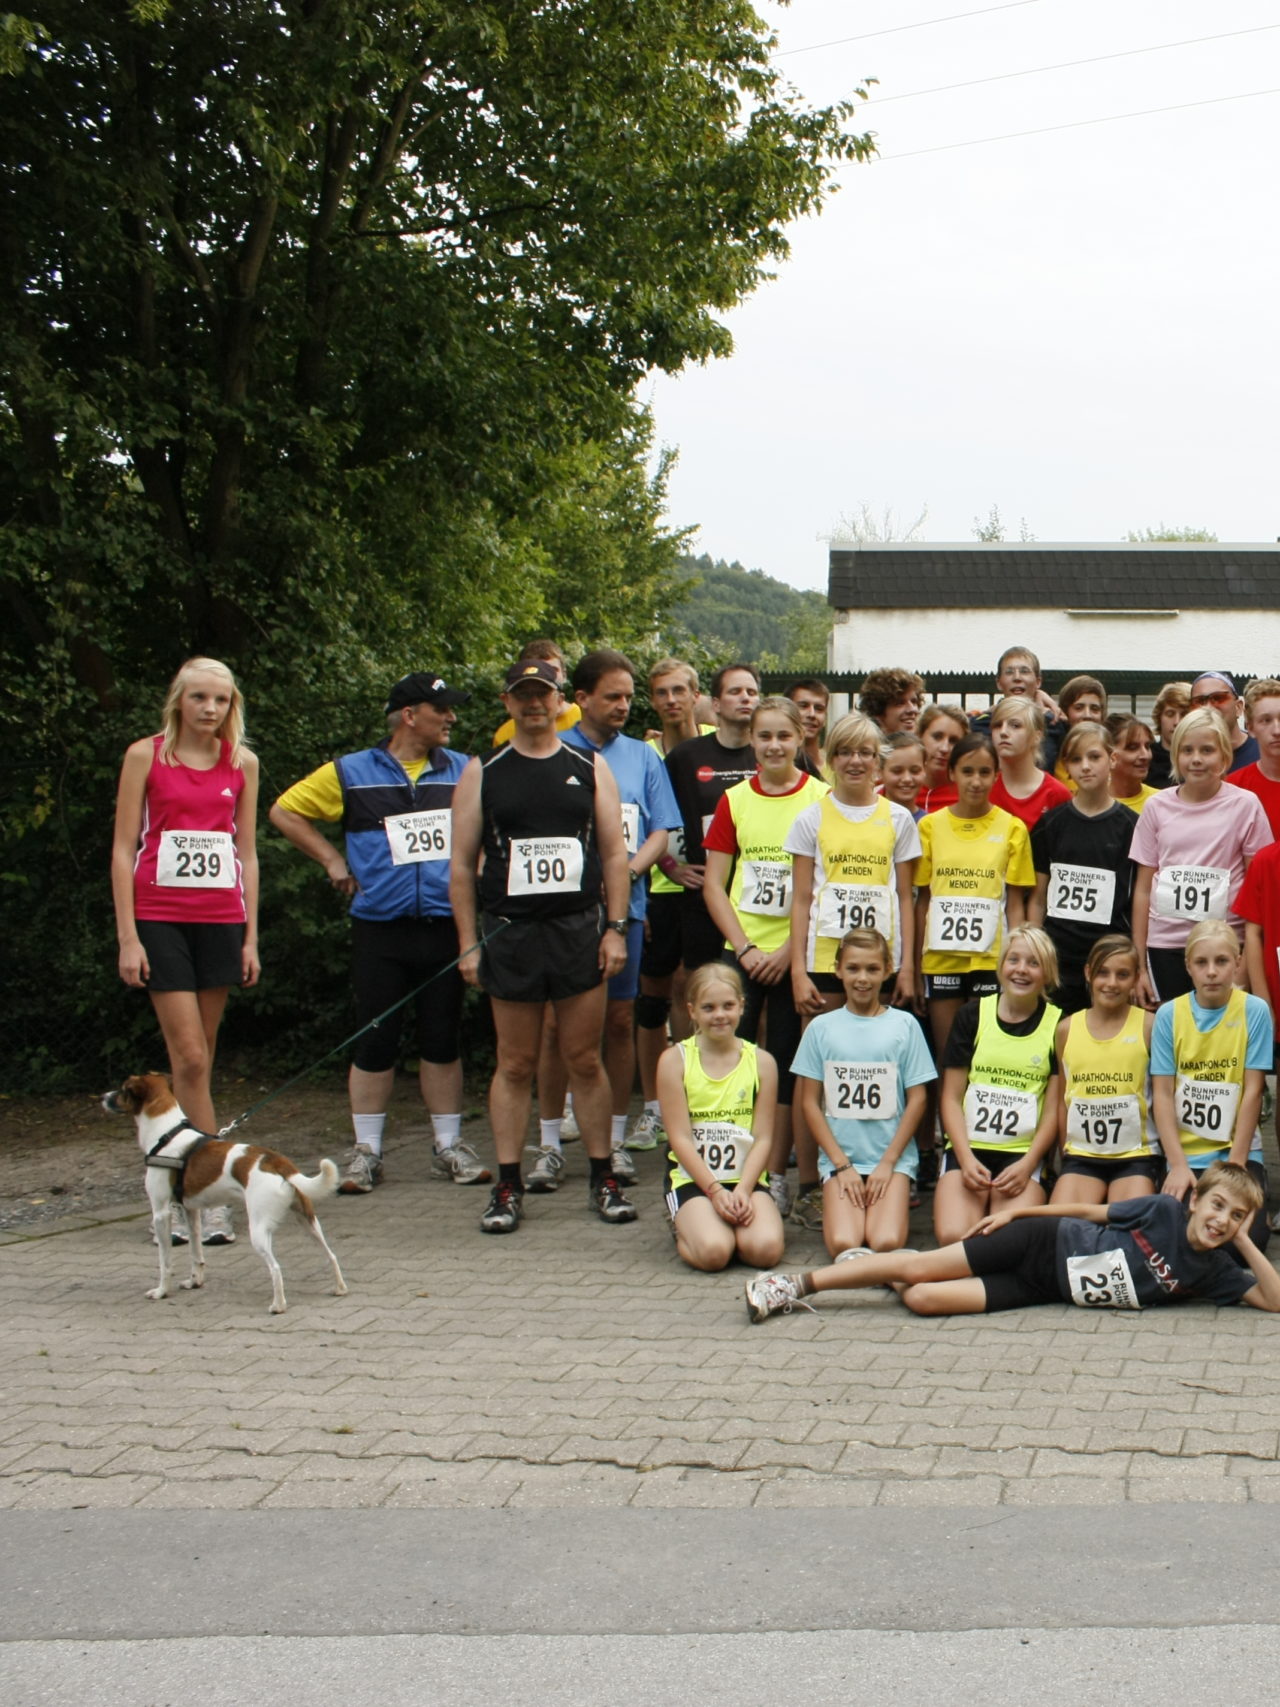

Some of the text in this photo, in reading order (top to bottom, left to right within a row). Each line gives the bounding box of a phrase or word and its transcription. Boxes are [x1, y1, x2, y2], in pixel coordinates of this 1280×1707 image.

[413, 814, 447, 825] RUNNERS
[414, 820, 435, 829] POINT
[190, 837, 226, 845] RUNNERS
[405, 829, 446, 854] 296
[534, 843, 572, 851] RUNNERS
[745, 846, 784, 855] MARATHO
[534, 849, 559, 857] POINT
[176, 852, 221, 878] 239
[829, 853, 888, 866] MARATHON-CLUB
[523, 858, 566, 885] 190
[763, 867, 791, 877] RUNNER
[842, 865, 873, 876] MENDEN
[936, 867, 995, 879] MARATHON-CLUB
[1183, 871, 1221, 881] RUNNERS
[1069, 877, 1093, 886] POINT
[1070, 871, 1107, 882] RUNNERS
[1183, 877, 1207, 885] POINT
[949, 879, 979, 889] MENDEN
[752, 881, 787, 908] 251
[849, 895, 872, 903] POINT
[850, 889, 883, 898] RUNNERS
[1056, 885, 1098, 912] 255
[1173, 885, 1212, 913] 191
[954, 902, 991, 911] RUNNERS
[837, 904, 877, 930] 196
[940, 916, 984, 942] 265
[1180, 1057, 1238, 1070] MARATHON-CLB
[849, 1067, 888, 1075] RUNNERS
[974, 1065, 1047, 1084] MARATHON-CLUB
[1072, 1072, 1134, 1083] MARATHON-CLUB
[1193, 1072, 1226, 1082] MENDEN
[990, 1076, 1027, 1090] MENDEN
[1085, 1085, 1118, 1096] MENDEN
[1191, 1086, 1230, 1096] RUNNERS
[837, 1083, 881, 1110] 246
[990, 1092, 1029, 1104] RUNNERS
[1191, 1093, 1215, 1102] POINT
[990, 1099, 1014, 1108] POINT
[1090, 1102, 1129, 1111] RUNNERS
[689, 1108, 753, 1119] MARATHON-CLUB
[1090, 1109, 1115, 1118] POINT
[1182, 1099, 1222, 1131] 250
[974, 1107, 1020, 1137] 242
[1081, 1118, 1123, 1145] 197
[697, 1143, 736, 1171] 192
[1080, 1273, 1113, 1306] 23
